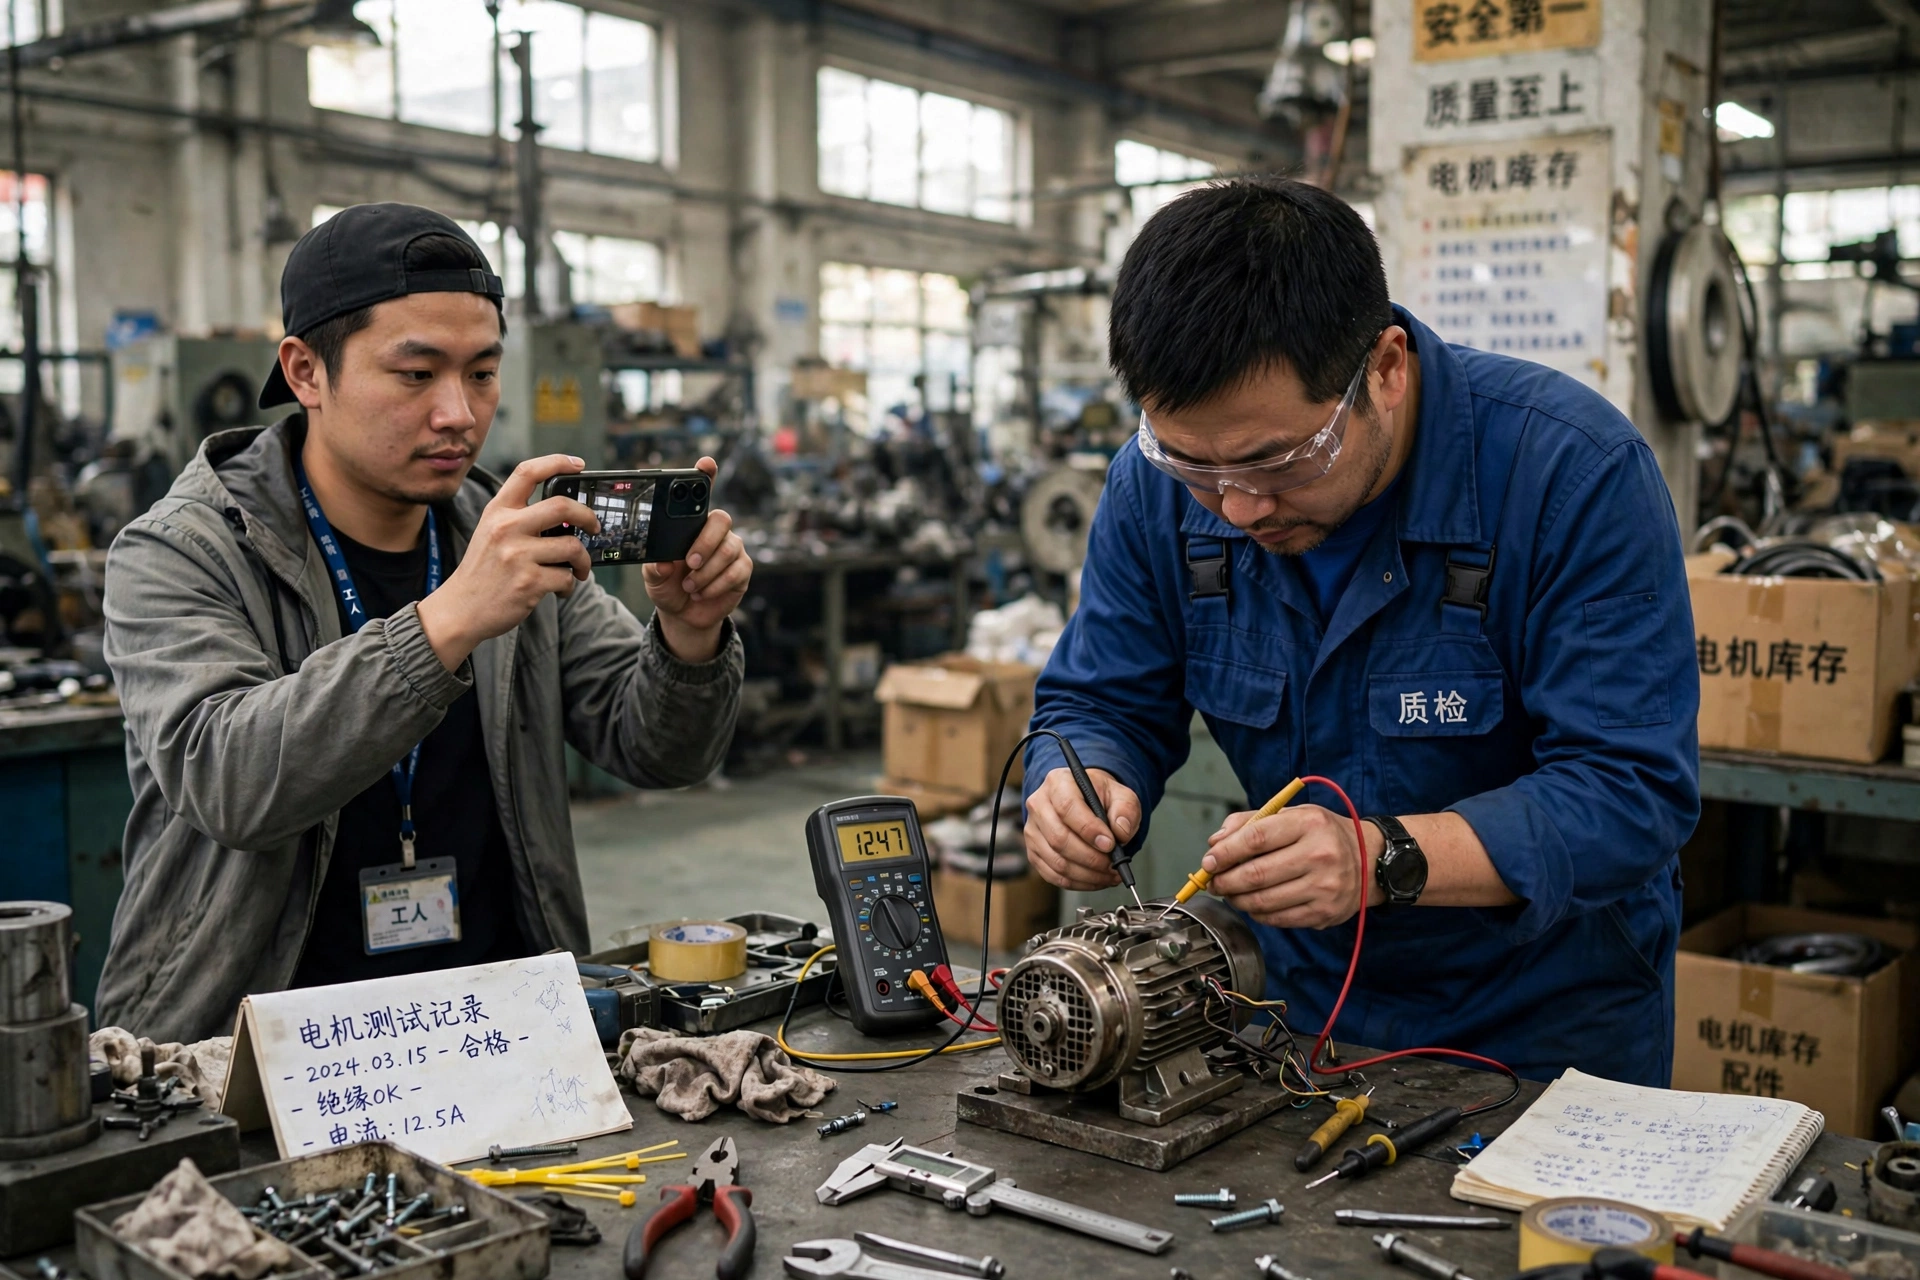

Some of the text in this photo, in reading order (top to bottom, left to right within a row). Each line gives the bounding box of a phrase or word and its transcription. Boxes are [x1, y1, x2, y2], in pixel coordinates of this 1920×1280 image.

[1424, 0, 1587, 47] 安全第一
[1425, 70, 1584, 129] 质量至上
[1428, 150, 1580, 196] 电机库存
[1696, 635, 1848, 685] 电机库存
[1398, 690, 1468, 725] 质检
[856, 827, 903, 856] 12.47
[391, 902, 428, 925] 工人
[299, 994, 490, 1050] 电机测试记录
[1698, 1013, 1822, 1066] 电机库存
[306, 1045, 428, 1083] 2024.03.15
[458, 1029, 511, 1059] 合格
[1721, 1058, 1784, 1098] 配件
